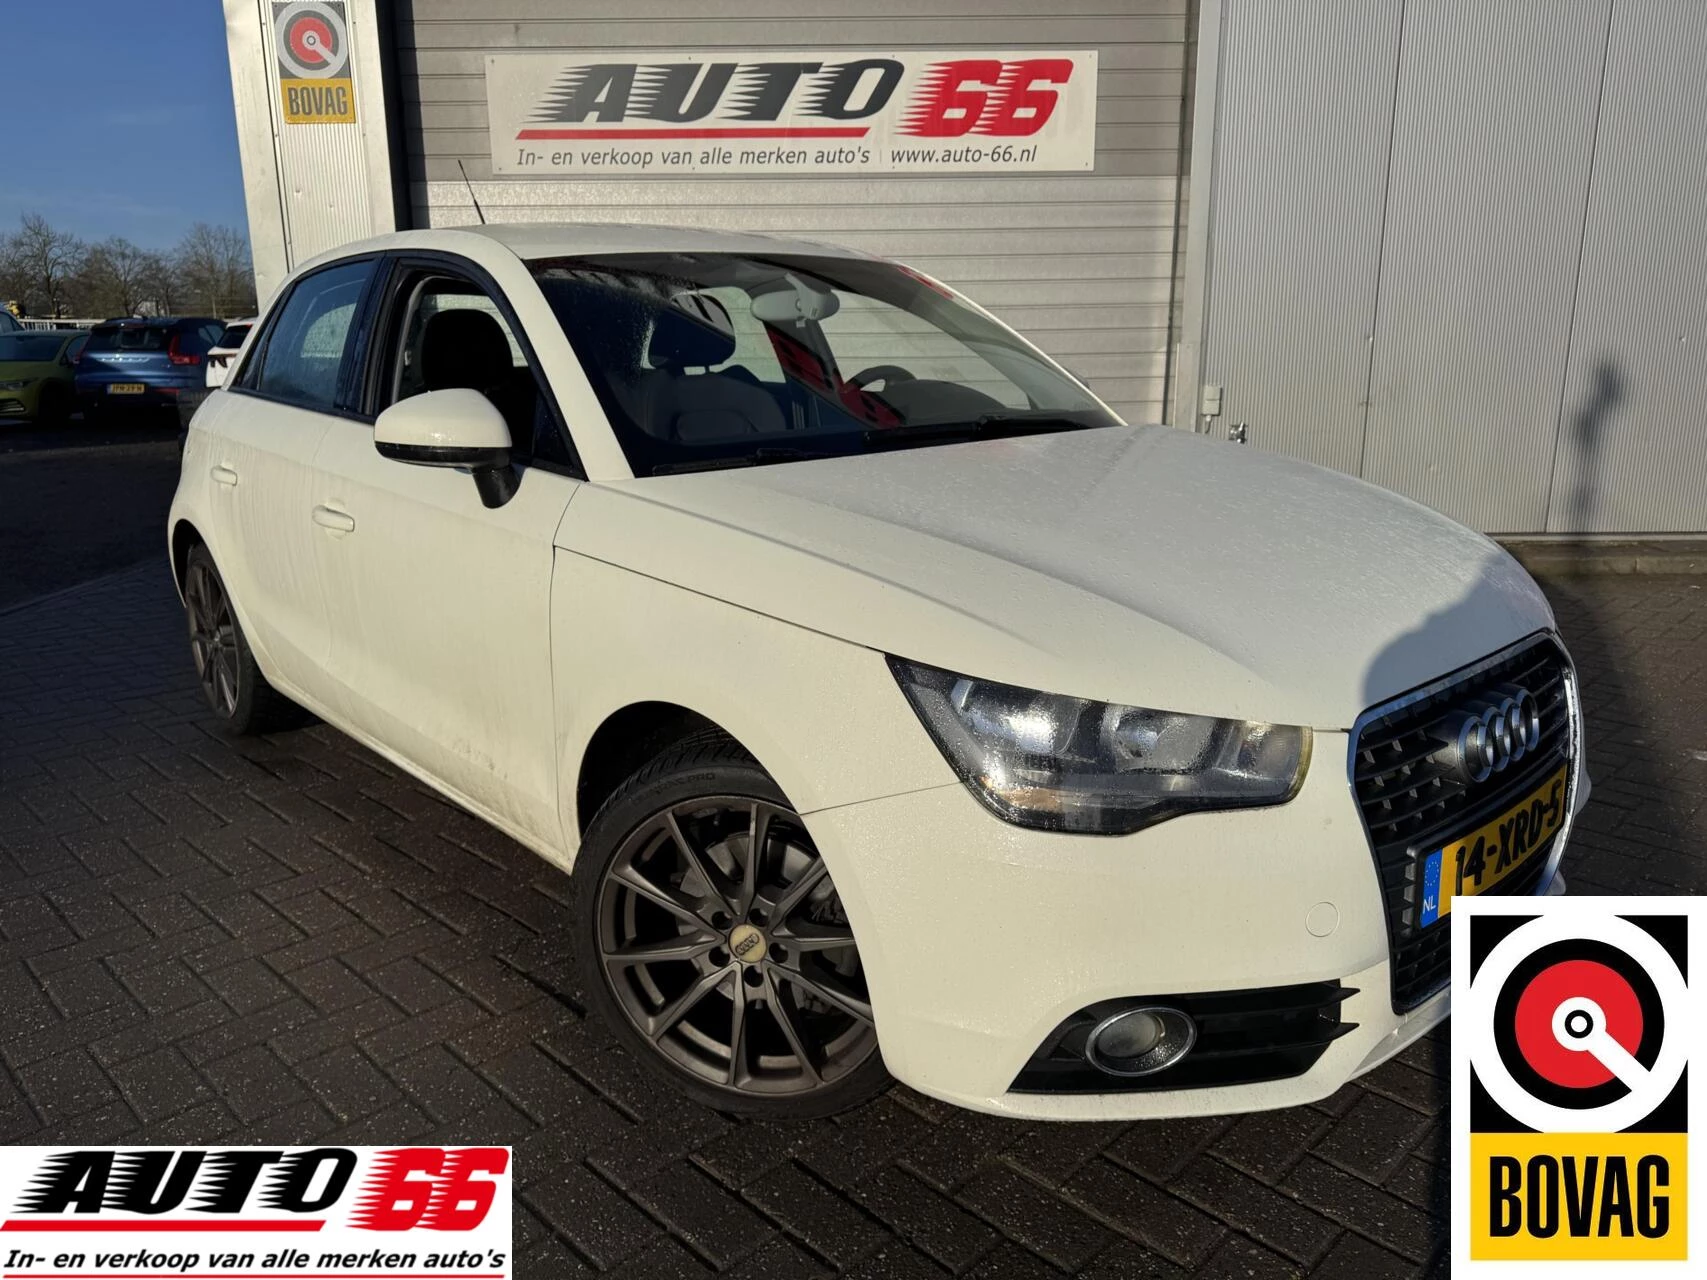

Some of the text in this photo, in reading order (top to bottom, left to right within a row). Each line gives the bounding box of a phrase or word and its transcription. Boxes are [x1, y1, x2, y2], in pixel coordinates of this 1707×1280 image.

[287, 86, 348, 116] BOVAG
[522, 58, 1074, 136] AUTO 66
[517, 145, 870, 169] In- en verkoop van alle merken auto's
[891, 145, 1038, 163] www.auto-66.nl
[1455, 779, 1562, 897] 14-XRD-5
[1422, 897, 1437, 914] NL
